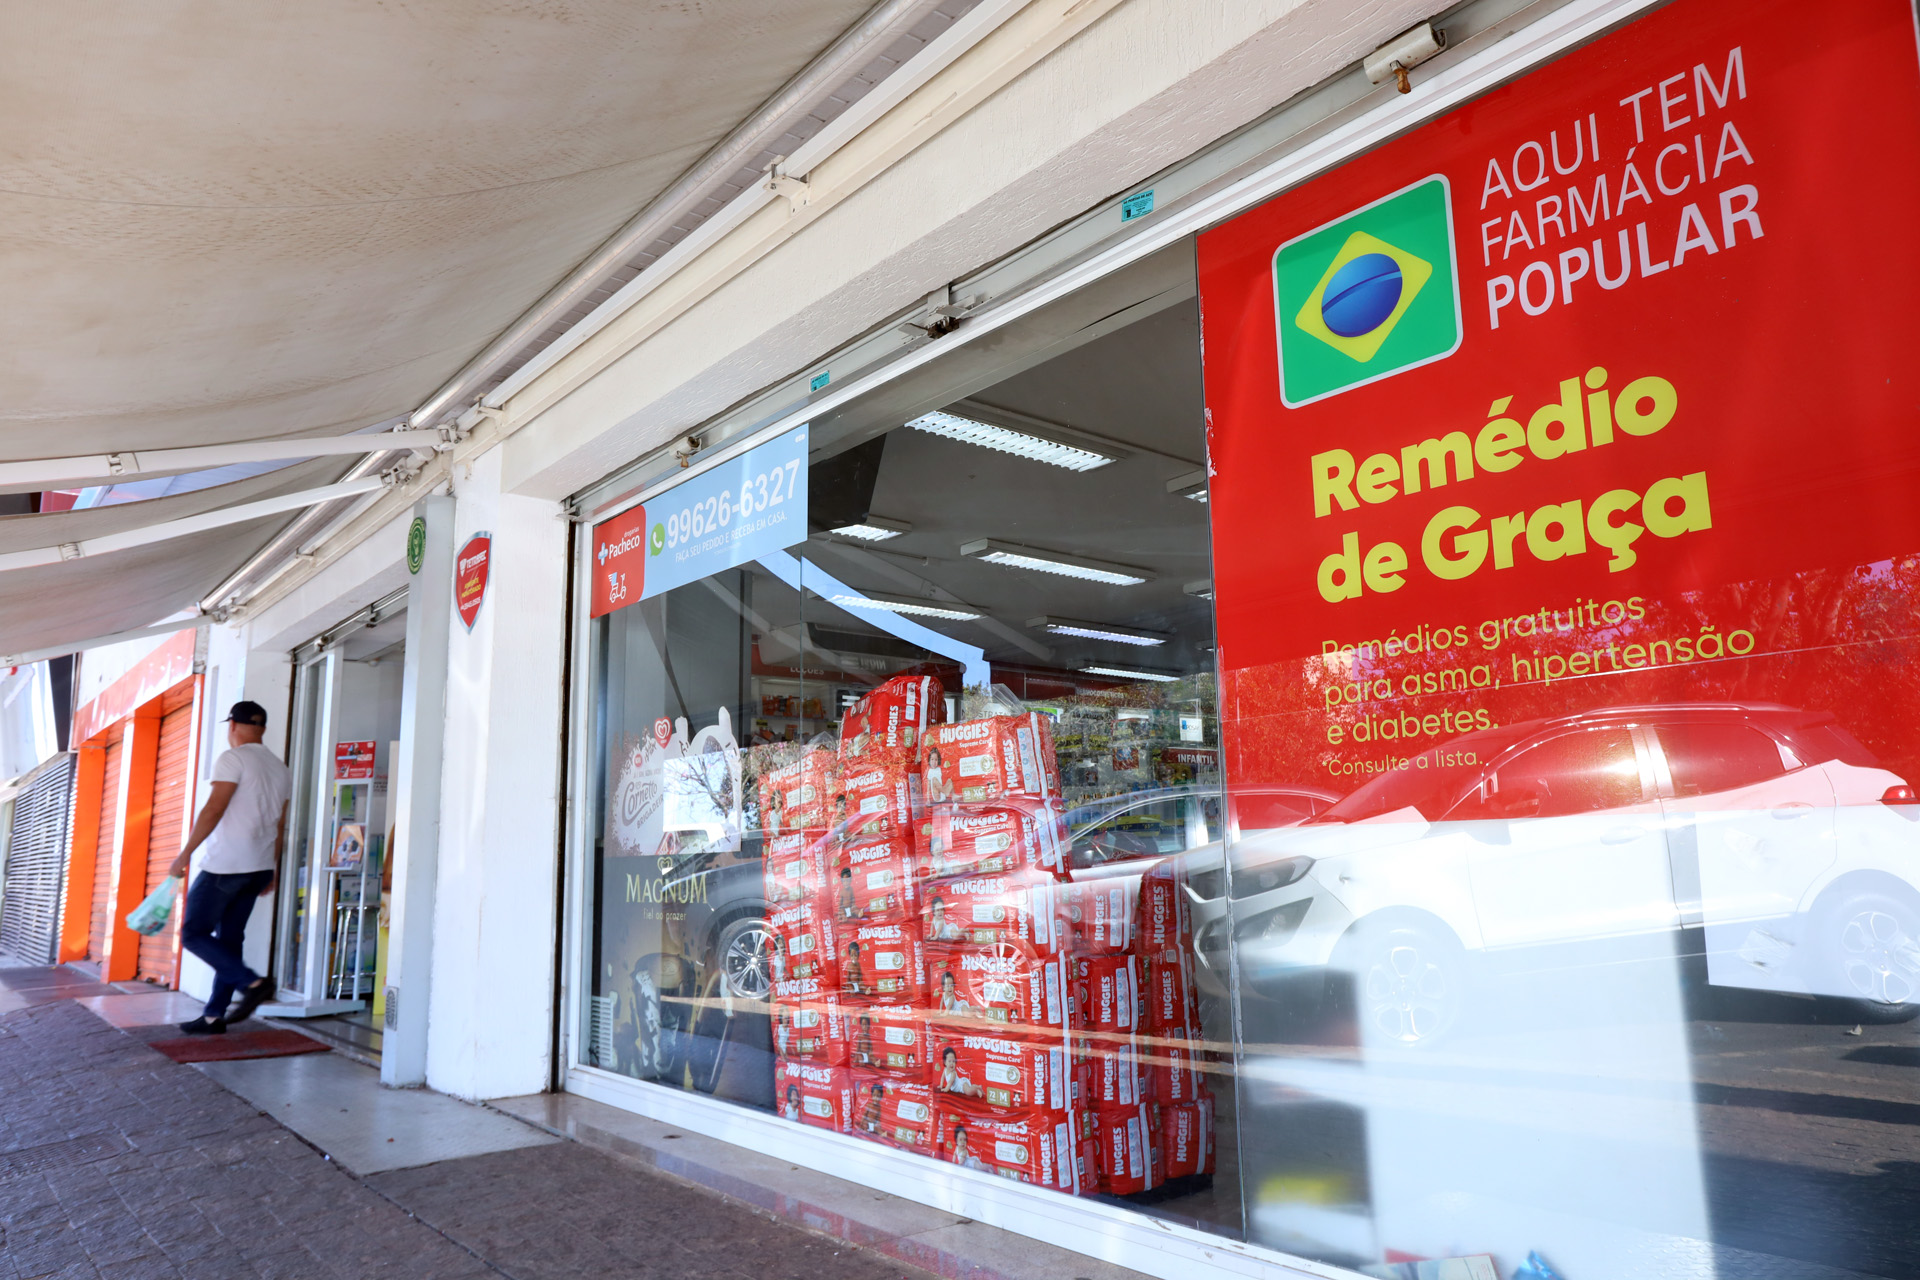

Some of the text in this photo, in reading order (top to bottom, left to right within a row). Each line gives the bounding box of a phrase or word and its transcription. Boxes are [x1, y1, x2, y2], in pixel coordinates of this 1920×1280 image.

[1480, 46, 1747, 209] AQUI TEM
[1482, 120, 1755, 267] FARMÁCIA
[1485, 183, 1765, 330] POPULAR
[1311, 365, 1678, 519] Remédio
[667, 458, 801, 549] 99626-6327
[609, 535, 641, 560] Pacheco
[624, 526, 640, 538] drogarias
[675, 550, 690, 564] FAÇA
[690, 546, 701, 557] SEU
[702, 534, 725, 553] PEDIDO
[731, 523, 755, 540] RECEBA
[756, 518, 767, 531] EM
[767, 510, 788, 527] CASA.
[1316, 471, 1713, 604] de Graça
[1321, 595, 1646, 667] Remédios gratuitos
[1324, 624, 1756, 713] para asma, hipertensão
[886, 705, 899, 747] HUGGIES
[939, 721, 990, 744] HUGGIES
[1326, 703, 1500, 746] e diabetes.
[769, 756, 814, 784] HUGGIES
[1003, 738, 1018, 788] HUGGIES
[1178, 753, 1215, 765] INFANTIL
[1415, 757, 1430, 769] a
[1434, 748, 1484, 768] lista.
[845, 771, 885, 791] HUGGIES
[895, 781, 907, 824] HUGGIES
[621, 779, 658, 827] Cornetto
[636, 792, 664, 829] BRIGADEIR
[950, 812, 1009, 832] HUGGIES
[849, 843, 891, 865] HUGGIES
[1022, 816, 1036, 863] HUGGIES
[625, 872, 708, 904] MAGNUM
[814, 846, 827, 888] HUGGIES
[902, 857, 914, 900] HUGGIES
[951, 878, 1005, 895] HUGGIES
[770, 903, 812, 928] HUGGIES
[857, 925, 901, 940] HUGGIES
[1095, 895, 1105, 941] HUGGIES
[1153, 885, 1165, 944] HUGGIES
[822, 919, 836, 960] HUGGIES
[914, 941, 925, 985] HUGGIES
[961, 955, 1016, 973] HUGGIES
[776, 978, 818, 997] HUGGIES
[1029, 971, 1042, 1020] HUGGIES
[1101, 976, 1111, 1023] HUGGIES
[1162, 970, 1173, 1019] HUGGIES
[827, 996, 839, 1039] HUGGIES
[963, 1035, 1021, 1056] HUGGIES
[985, 1053, 1008, 1062] Supreme
[785, 1062, 831, 1084] HUGGIES
[1034, 1054, 1045, 1105] HUGGIES
[1104, 1053, 1114, 1100] HUGGIES
[1170, 1049, 1181, 1099] HUGGIES
[841, 1089, 853, 1132] HUGGIES
[994, 1132, 1029, 1143] Supreme Care
[1112, 1127, 1124, 1176] HUGGIES
[1176, 1111, 1188, 1162] HUGGIES
[1040, 1133, 1053, 1185] HUGGIES
